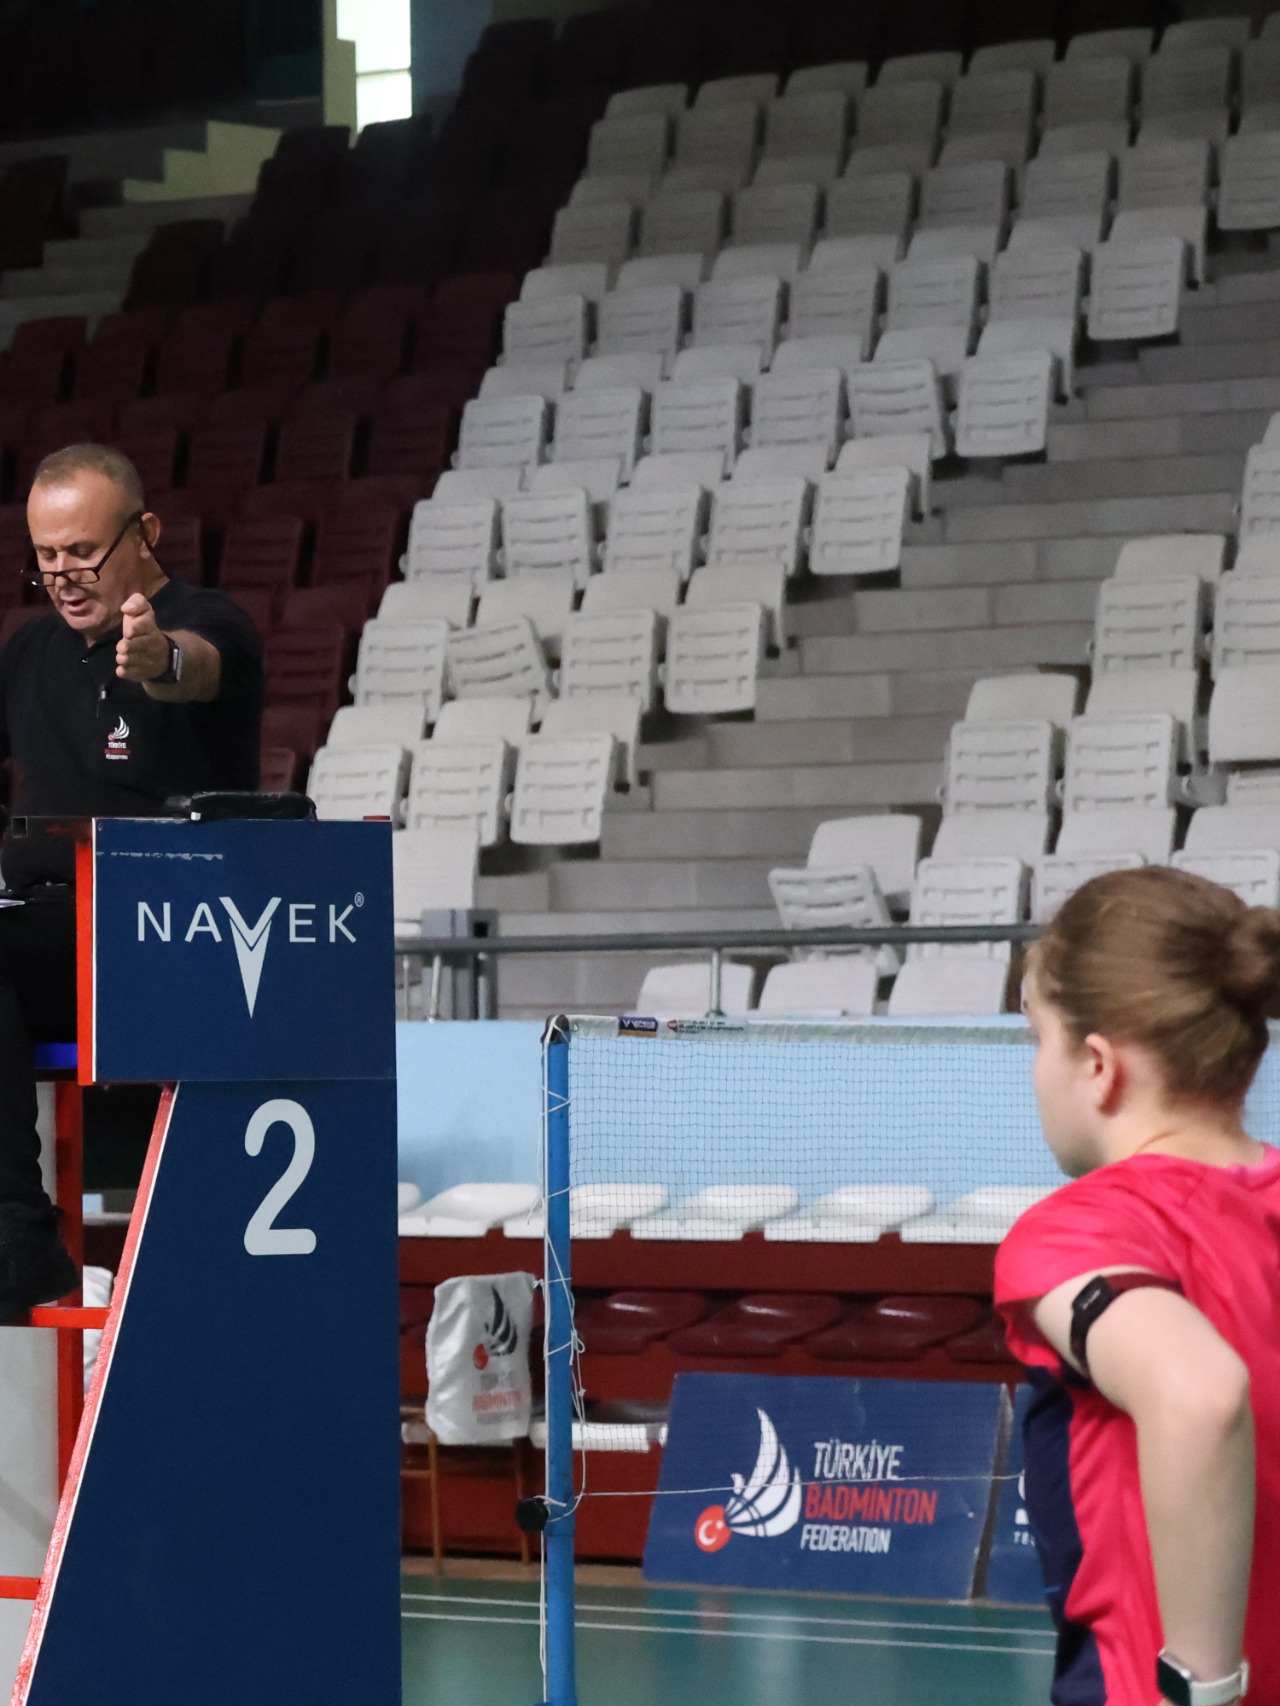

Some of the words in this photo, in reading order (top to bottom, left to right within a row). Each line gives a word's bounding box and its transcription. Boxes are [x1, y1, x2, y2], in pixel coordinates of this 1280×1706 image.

[243, 1099, 316, 1256] 2
[813, 1438, 904, 1480] TÜRKİYE
[800, 1523, 892, 1554] FEDERATION
